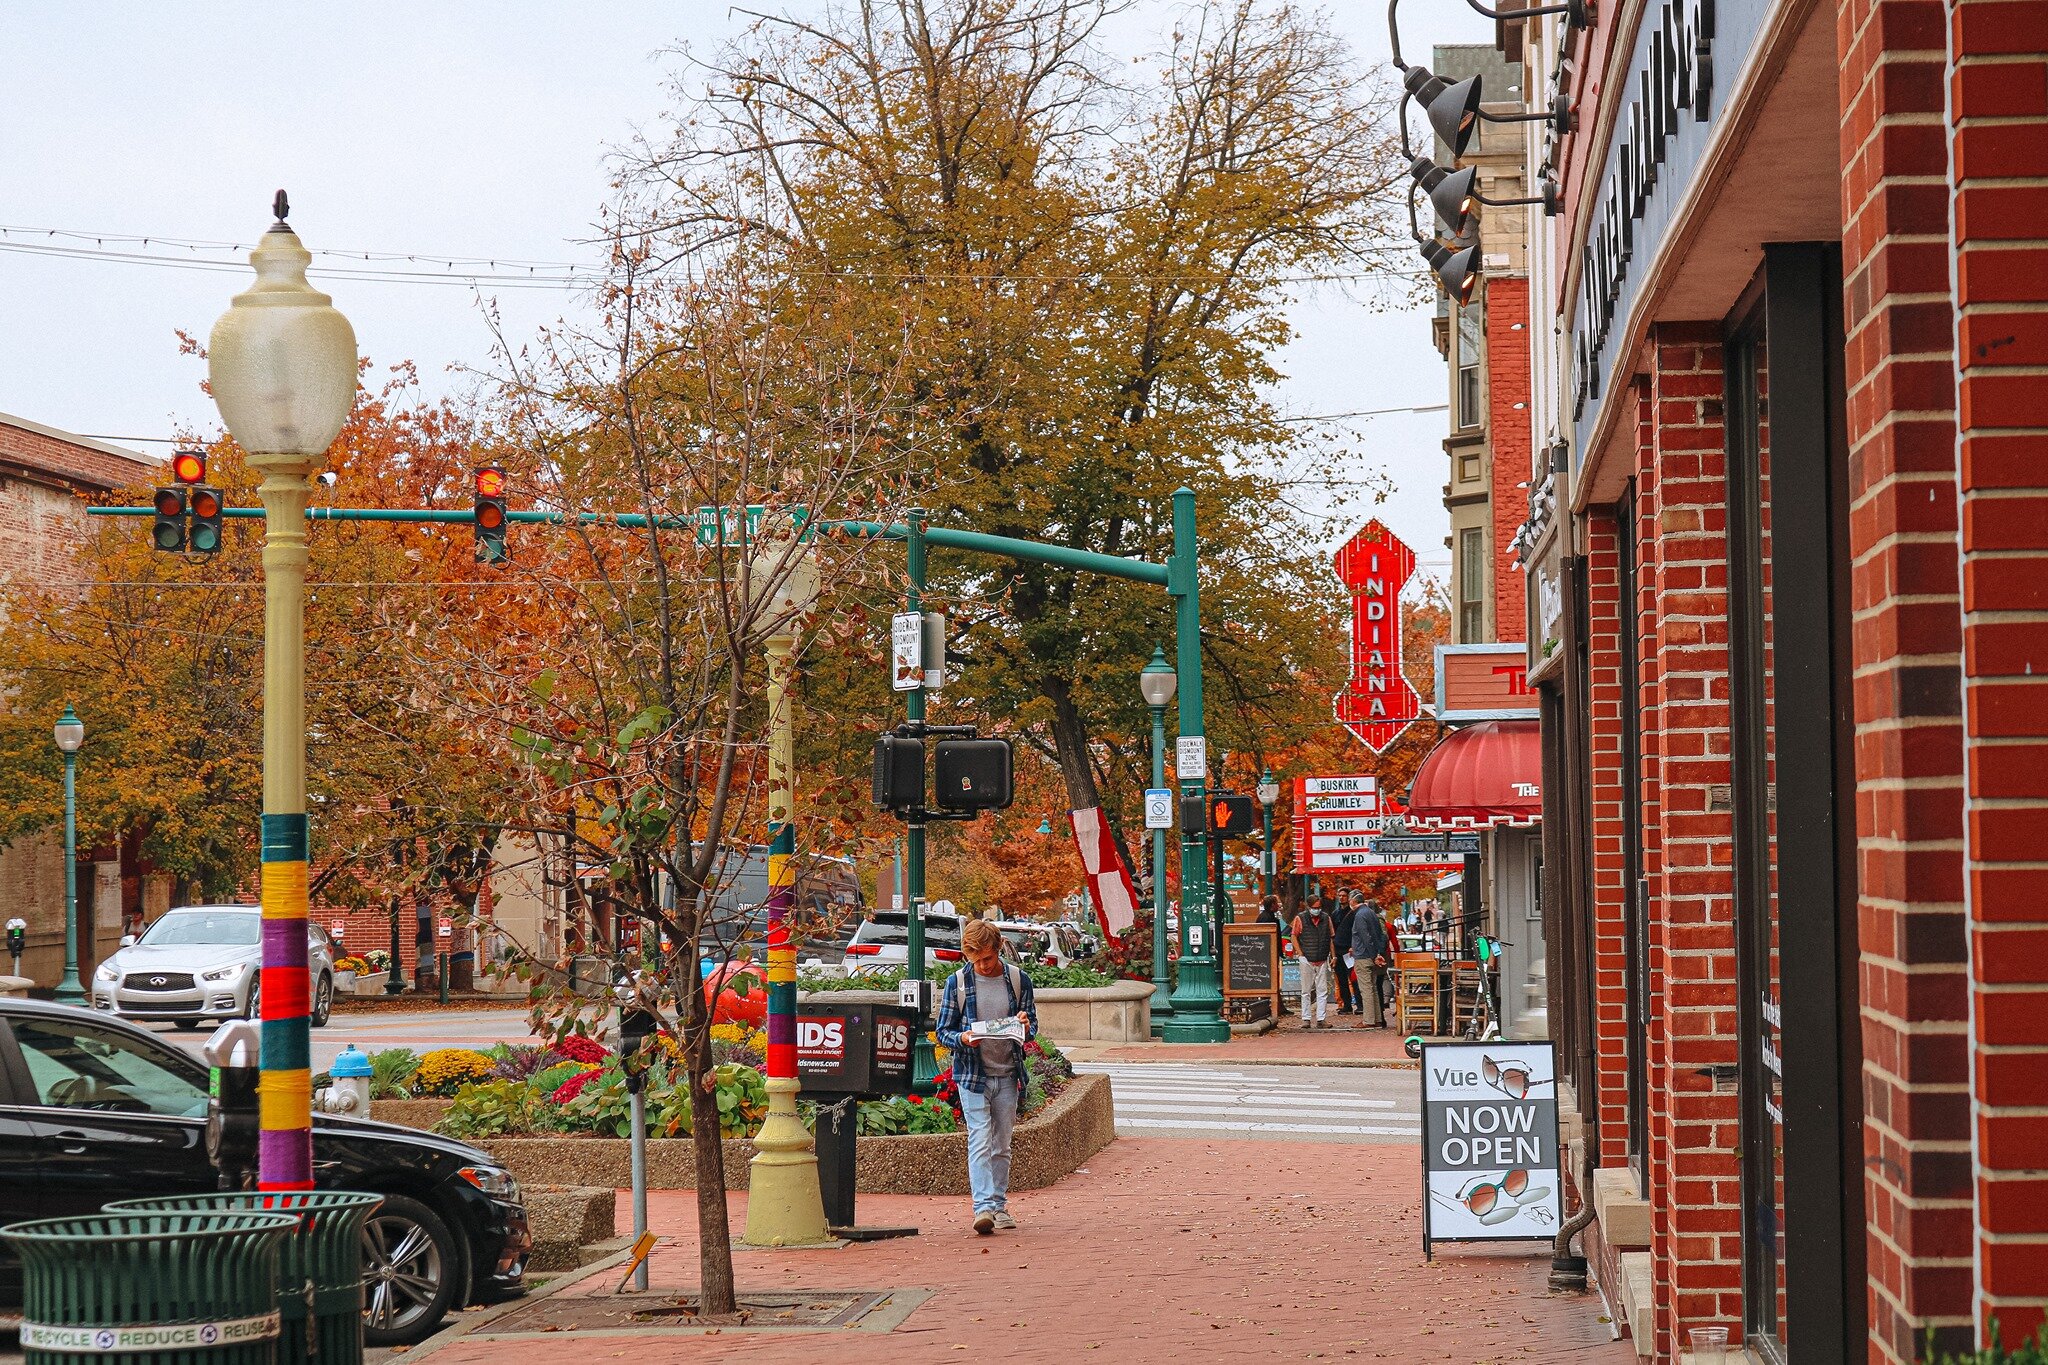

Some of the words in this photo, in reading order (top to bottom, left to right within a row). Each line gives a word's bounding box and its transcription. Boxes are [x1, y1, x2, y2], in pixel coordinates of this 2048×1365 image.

[1366, 553, 1387, 716] INDIANA
[1320, 779, 1359, 791] BUSKIRK
[1511, 783, 1540, 797] THE
[1319, 797, 1362, 809] CHUMLEY
[1317, 820, 1355, 831] SPIRIT
[1367, 819, 1381, 830] OF
[1379, 841, 1424, 852] PARKING
[1448, 840, 1478, 851] BACK
[1341, 855, 1365, 865] WED
[797, 1022, 843, 1048] IDS
[877, 1024, 908, 1051] IDS
[797, 1060, 840, 1068] idsnews.com
[877, 1061, 906, 1070] idsnews.com
[1445, 1105, 1536, 1135] NOW
[1441, 1136, 1541, 1166] OPEN
[32, 1330, 91, 1346] RECYCLE
[118, 1329, 197, 1347] REDUCE
[223, 1320, 265, 1339] REUSE
